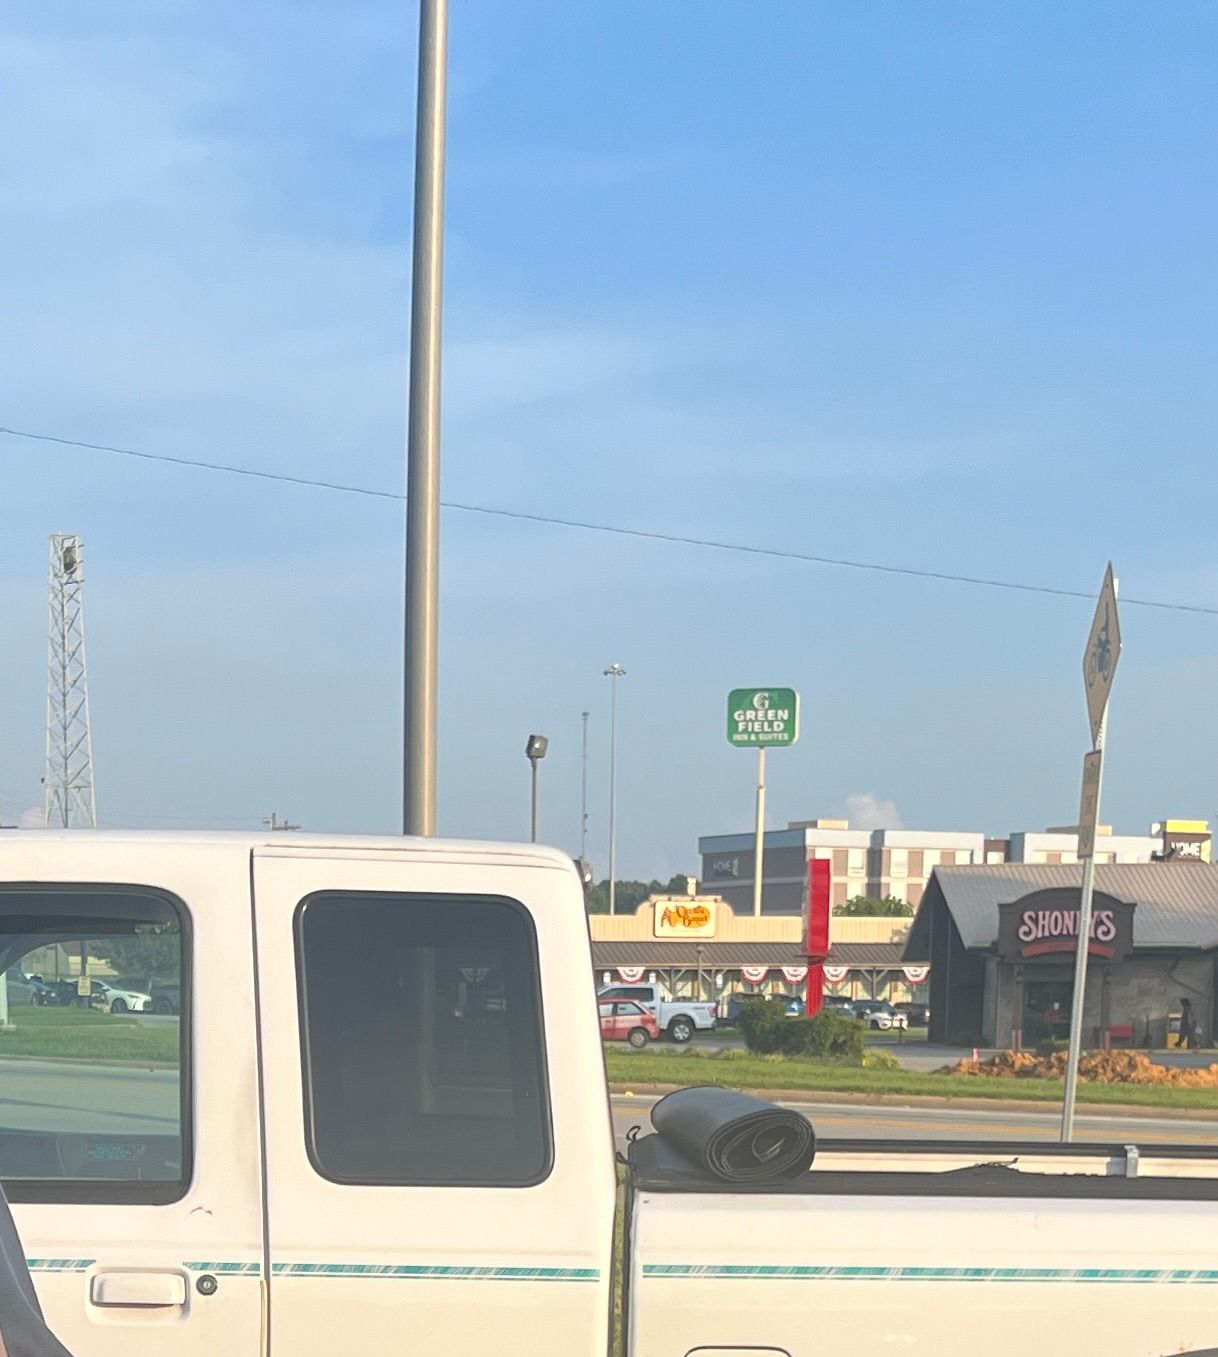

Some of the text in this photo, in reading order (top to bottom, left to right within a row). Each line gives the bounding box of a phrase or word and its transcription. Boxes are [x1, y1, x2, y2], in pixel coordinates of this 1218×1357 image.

[733, 709, 789, 721] GREEN
[738, 721, 784, 732] FIELD
[1018, 910, 1117, 942] SHONY'S
